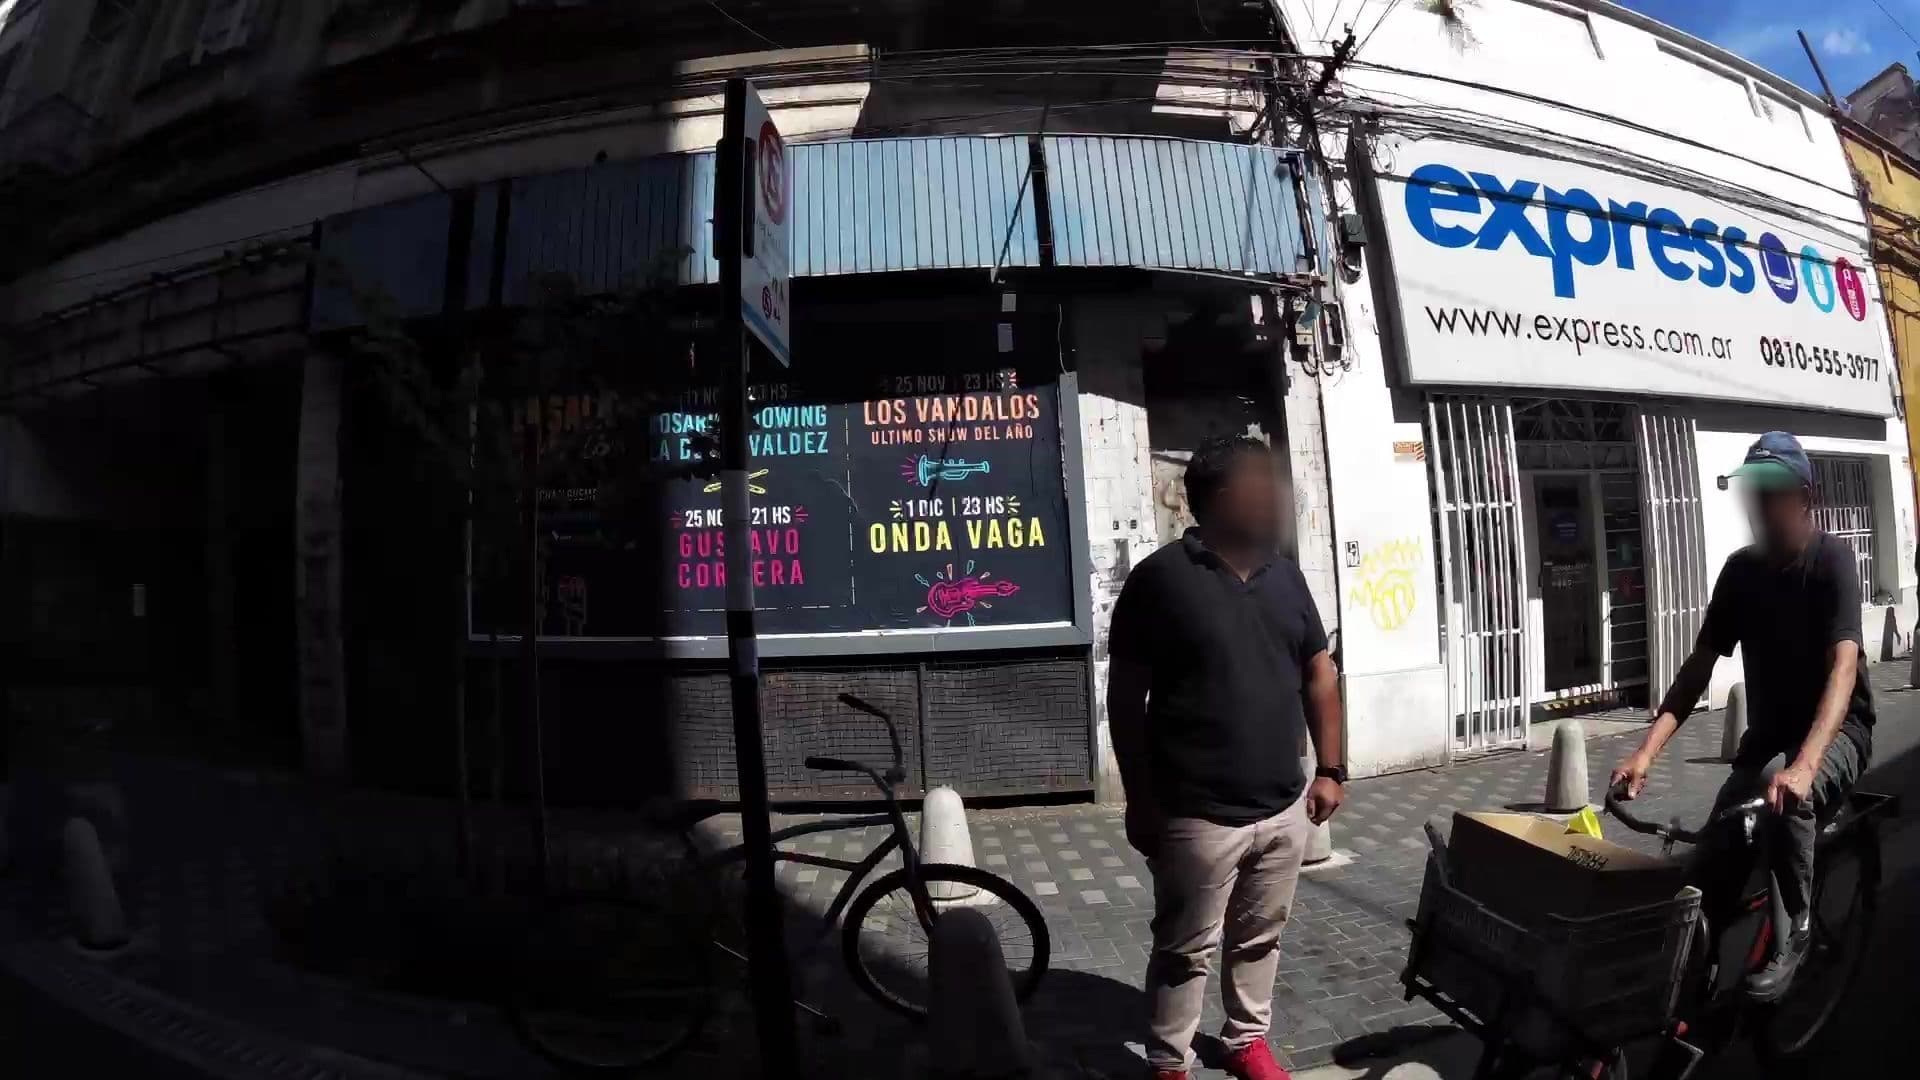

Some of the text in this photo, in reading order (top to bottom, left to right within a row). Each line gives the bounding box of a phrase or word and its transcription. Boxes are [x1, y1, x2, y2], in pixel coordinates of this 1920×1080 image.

[1405, 163, 1756, 298] express
[1424, 306, 1879, 382] www.express.com.ar 0810-555-3977
[895, 376, 912, 392] 25
[917, 375, 945, 392] NOV
[963, 374, 981, 390] 23
[864, 394, 1040, 425] LOS VANDALOS
[748, 431, 829, 457] VALDEZ
[871, 428, 922, 445] ULTIMO
[974, 425, 1000, 441] DEL
[1005, 422, 1033, 440] AÑO
[685, 506, 791, 528] 25 NO 21 HS
[906, 496, 1005, 517] 1 DIC 23 HS
[679, 529, 800, 558] GUSAVO
[870, 517, 1045, 553] ONDA VAGA
[678, 559, 805, 589] CORERA
